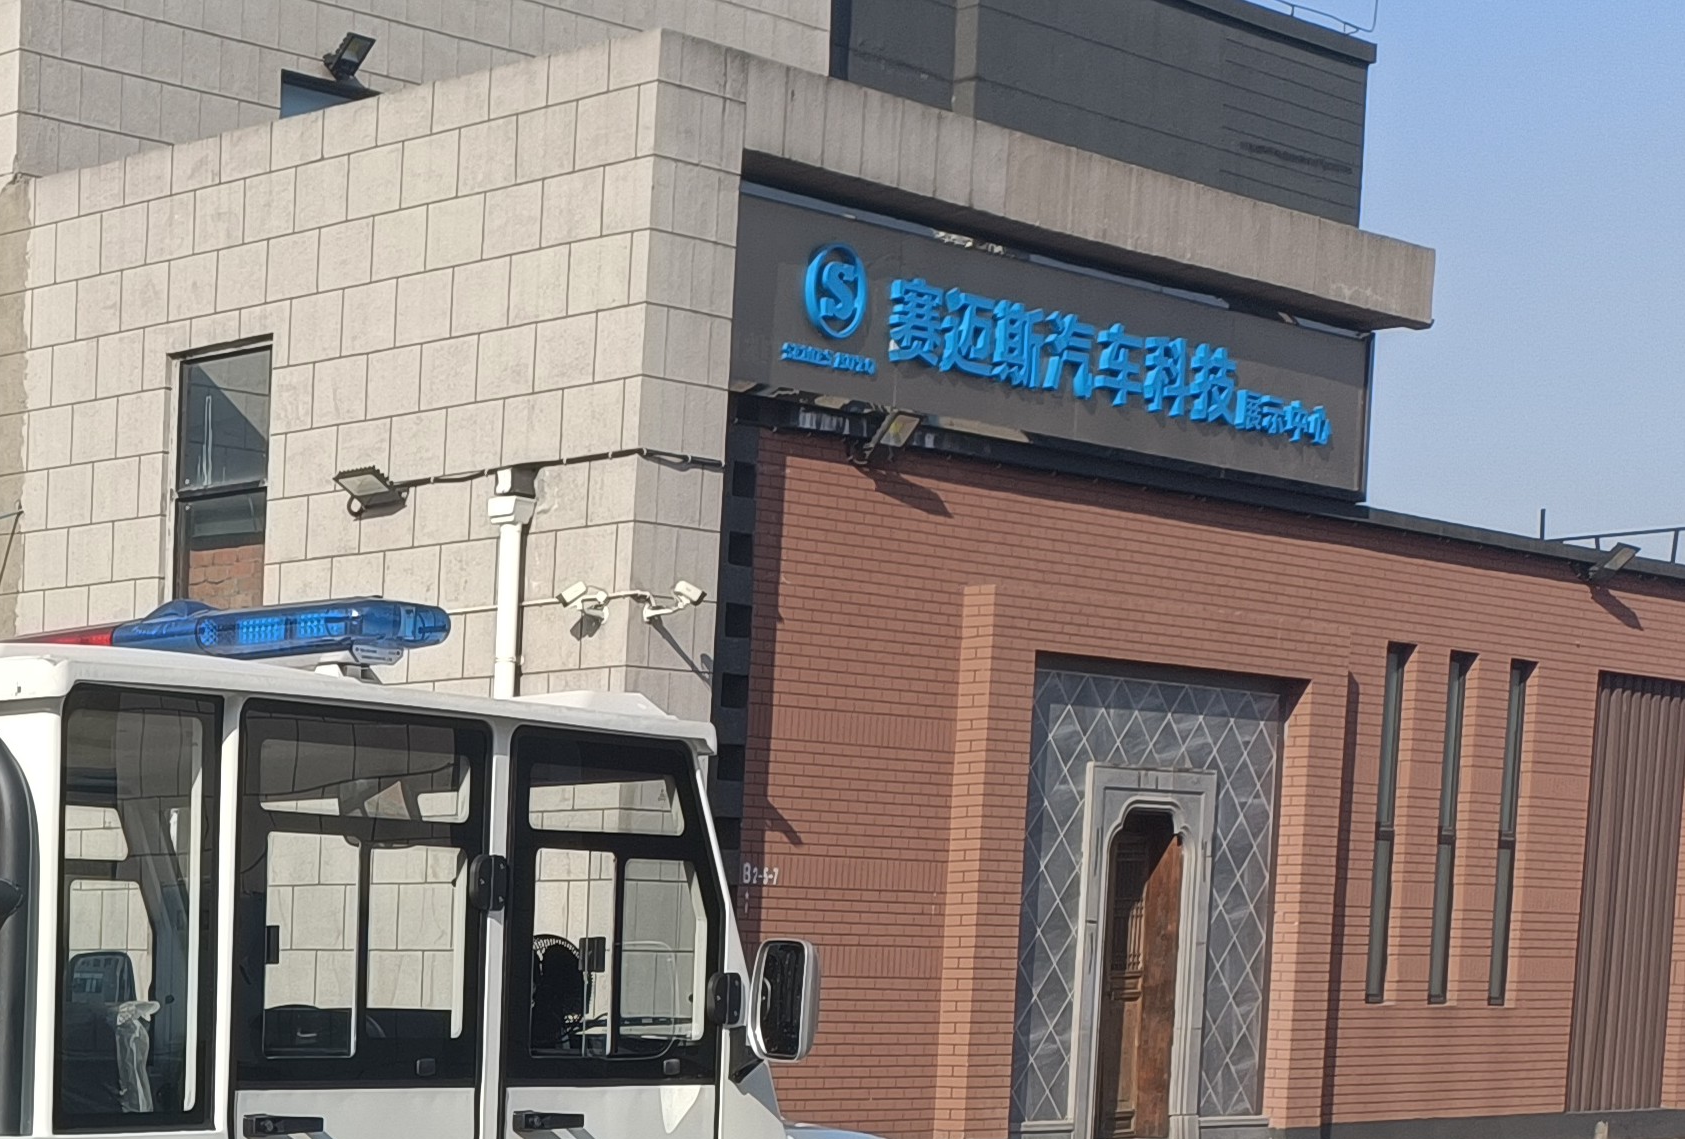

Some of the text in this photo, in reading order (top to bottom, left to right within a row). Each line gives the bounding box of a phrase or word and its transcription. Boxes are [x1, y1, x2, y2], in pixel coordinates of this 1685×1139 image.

[888, 278, 1241, 424] 赛迈斯汽车科技
